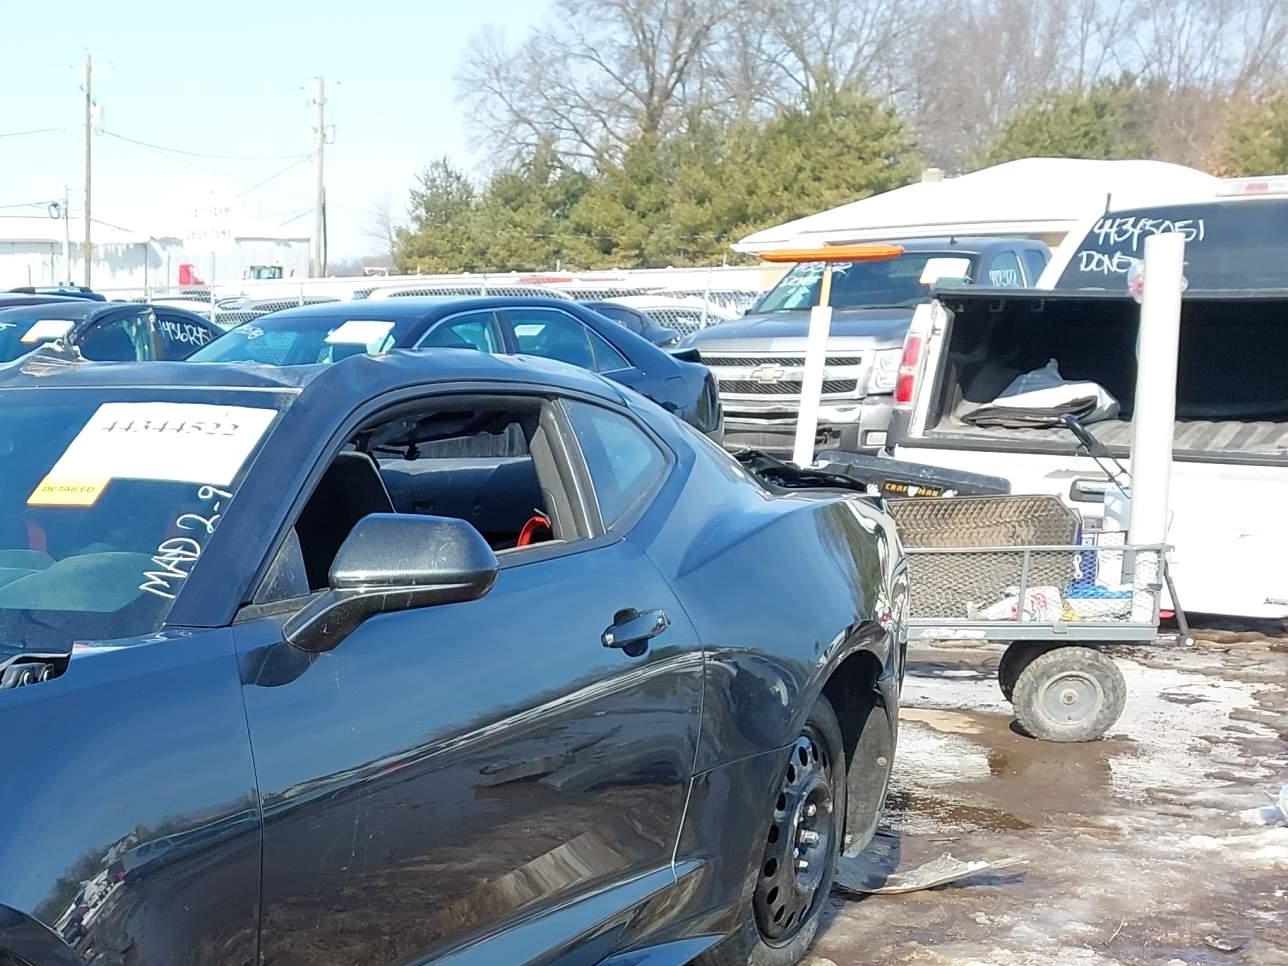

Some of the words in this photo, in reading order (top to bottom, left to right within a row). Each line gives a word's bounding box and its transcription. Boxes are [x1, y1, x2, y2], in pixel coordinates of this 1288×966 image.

[40, 484, 97, 494] DETAILED
[884, 482, 940, 497] CRAFMAN
[137, 536, 203, 599] MAD
